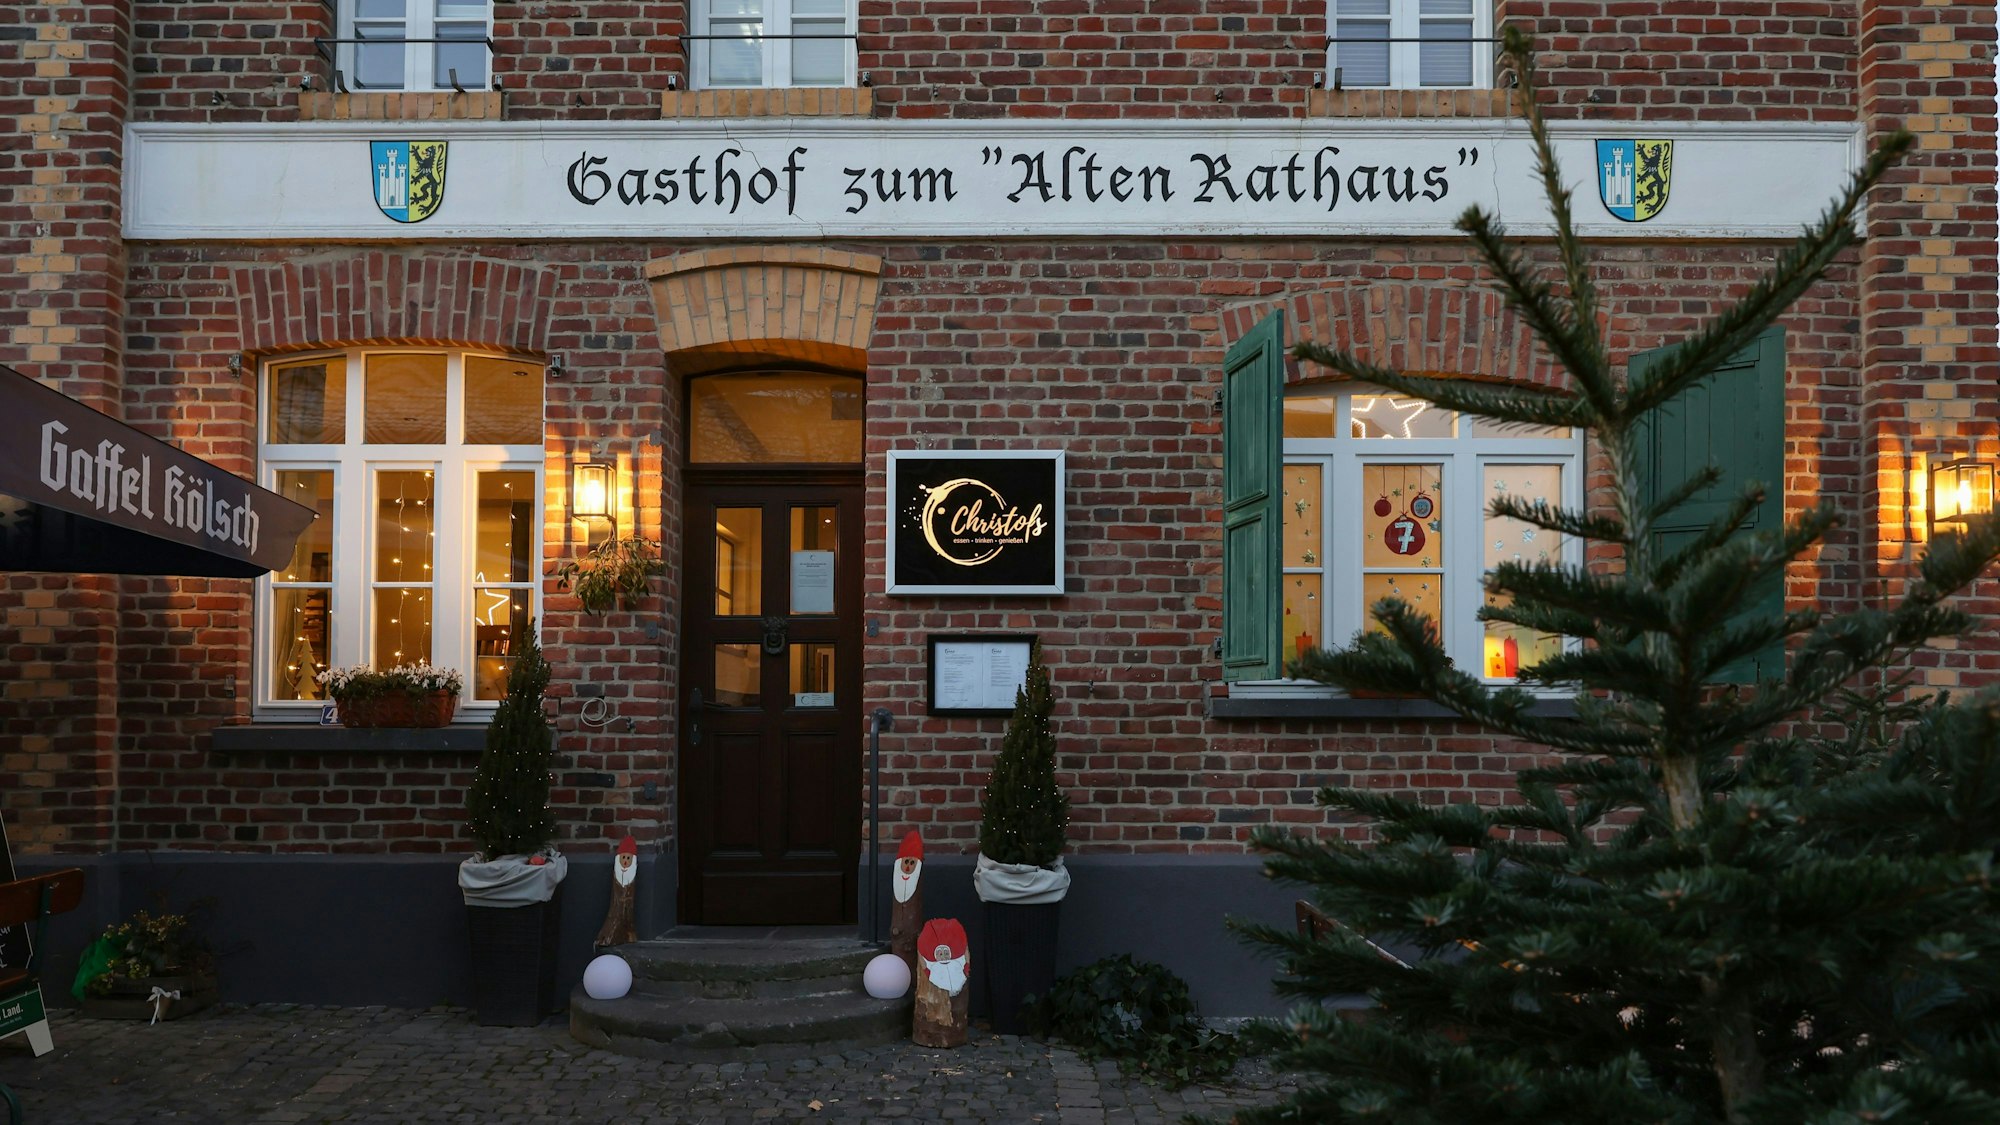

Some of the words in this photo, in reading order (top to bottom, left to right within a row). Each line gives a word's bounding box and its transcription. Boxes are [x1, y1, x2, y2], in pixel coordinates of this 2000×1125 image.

[567, 147, 808, 216] Gasthof
[843, 166, 958, 214] zum
[40, 419, 155, 520] Gaffel
[163, 464, 260, 556] Kölsch
[951, 499, 1048, 543] Christofs
[1394, 521, 1415, 553] 7
[998, 537, 1024, 545] genießen
[325, 707, 339, 723] 4
[2, 1002, 24, 1019] Land.
